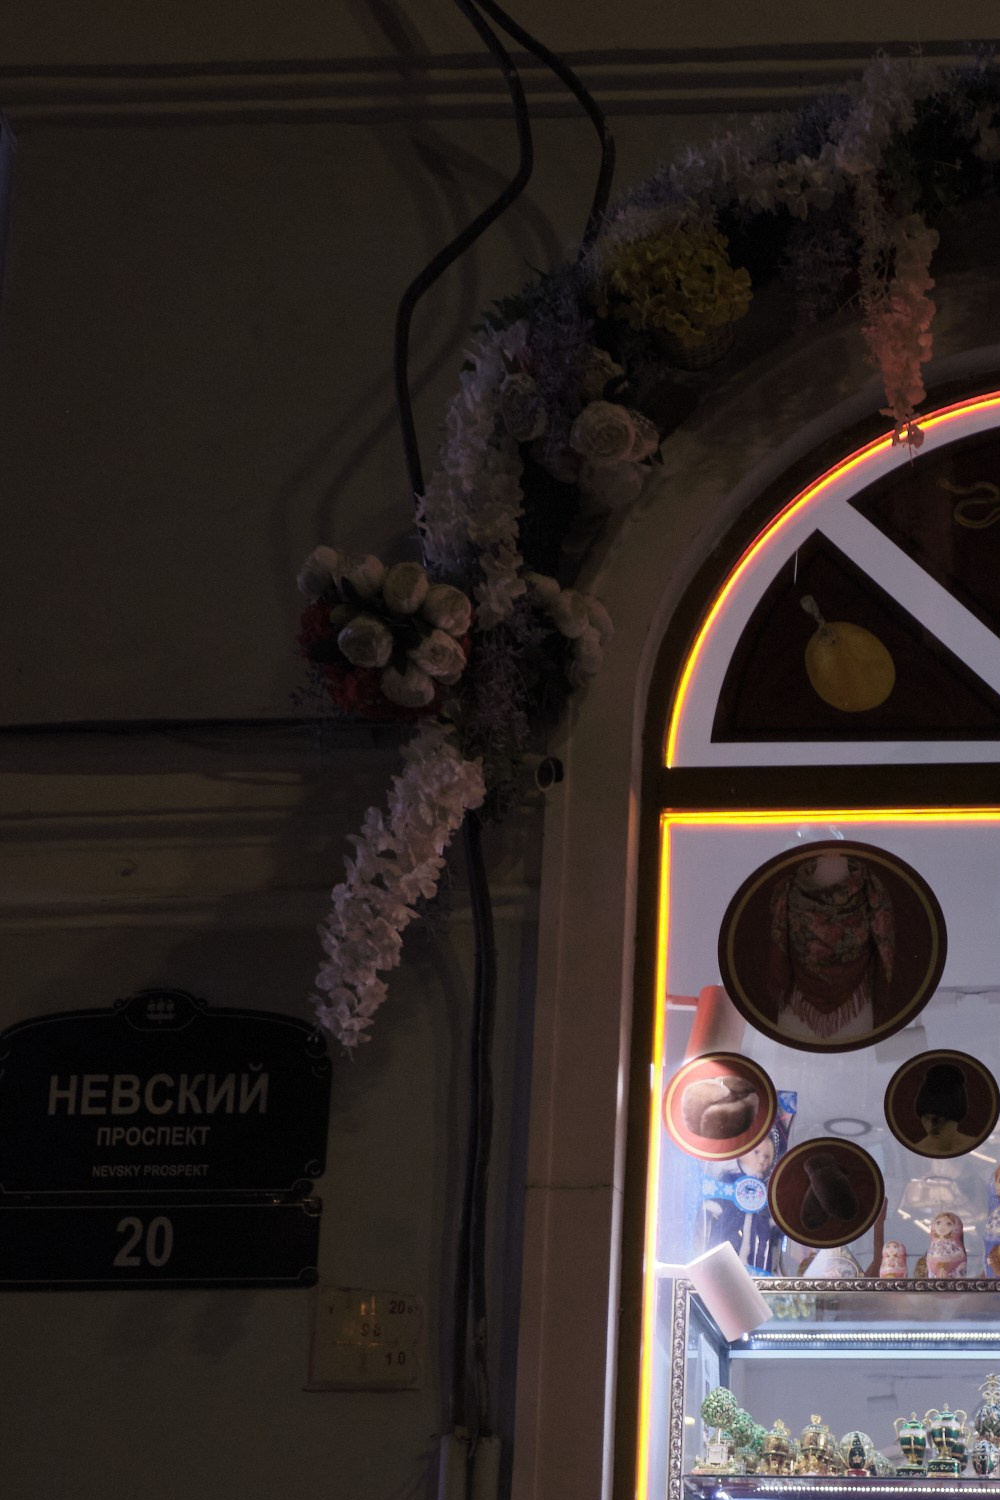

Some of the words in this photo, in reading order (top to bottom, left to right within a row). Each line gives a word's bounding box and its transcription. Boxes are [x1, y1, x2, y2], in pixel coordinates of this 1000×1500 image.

[47, 1060, 271, 1116] НЕВСКИЙ
[96, 1126, 211, 1147] ПРОСПЕКТ
[91, 1164, 142, 1178] NEVSKY
[143, 1163, 210, 1177] PROSPEKT
[112, 1215, 174, 1268] 20
